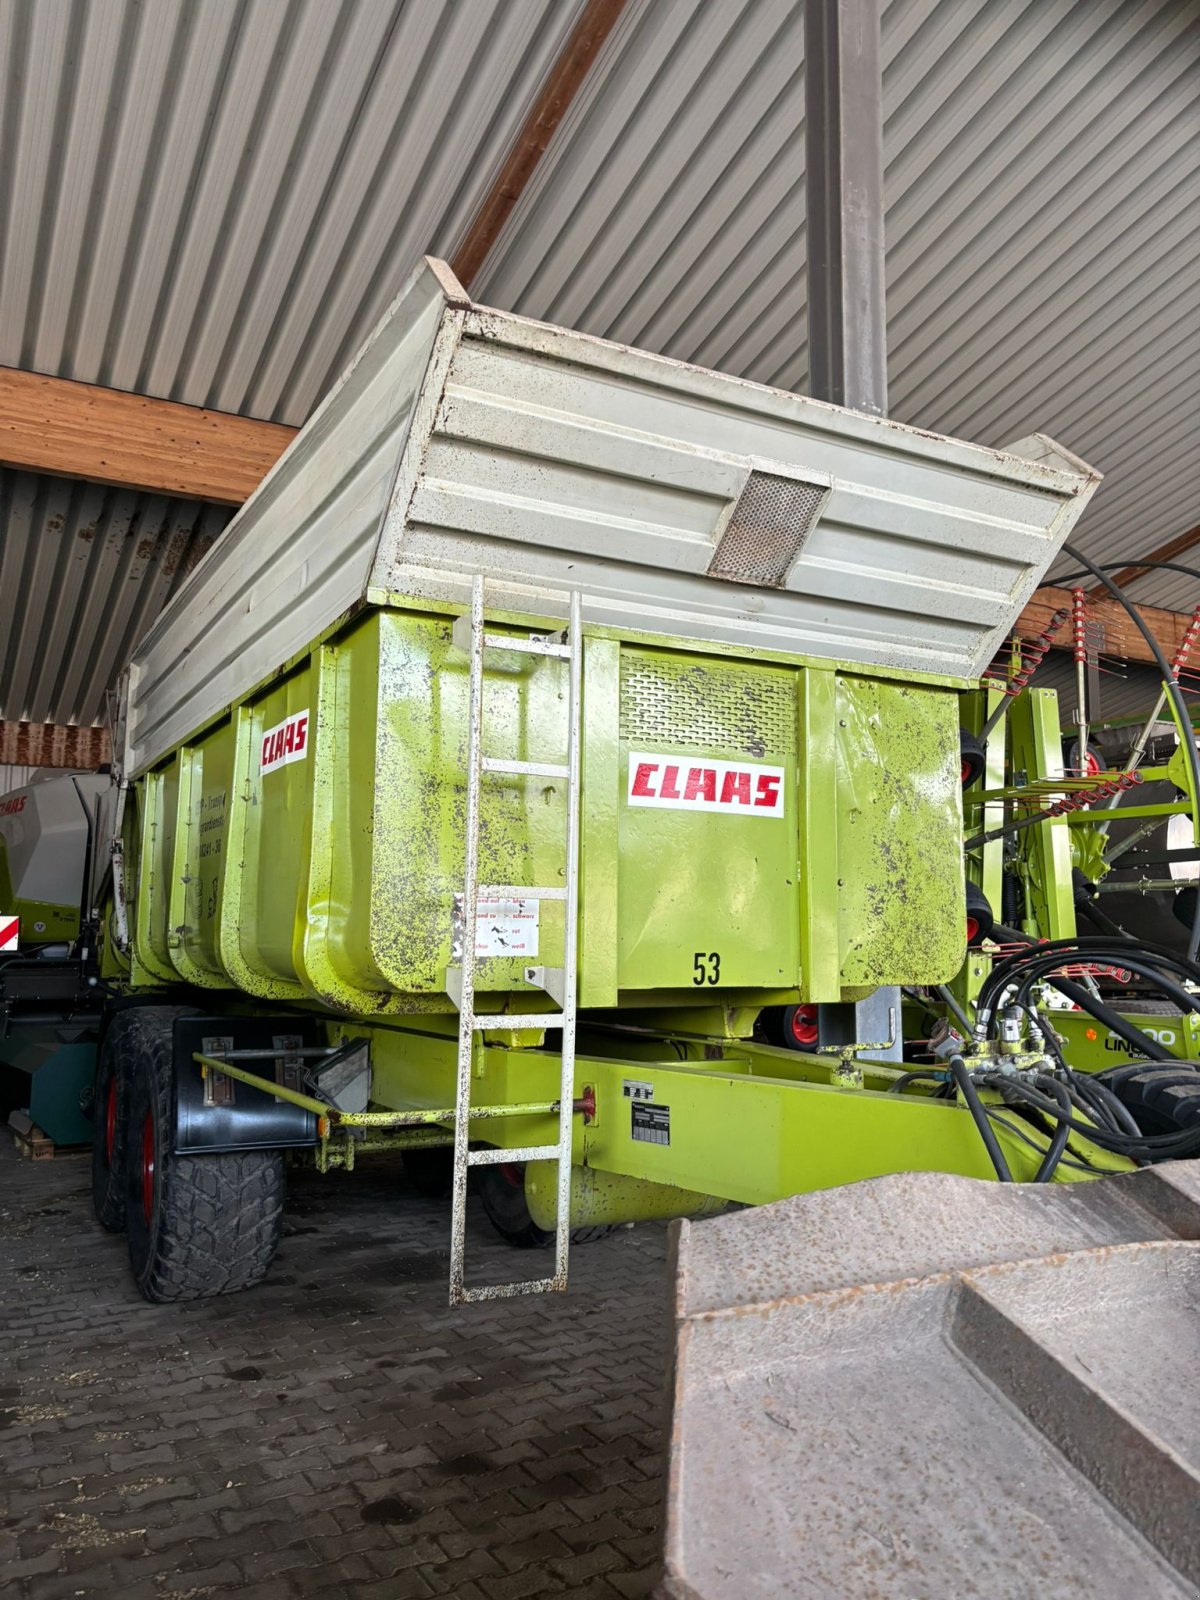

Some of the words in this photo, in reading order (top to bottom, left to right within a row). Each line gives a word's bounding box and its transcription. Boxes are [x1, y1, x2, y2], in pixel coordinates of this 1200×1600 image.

[262, 717, 308, 767] CLAAS
[631, 762, 781, 807] CLAAS
[692, 952, 721, 986] 53
